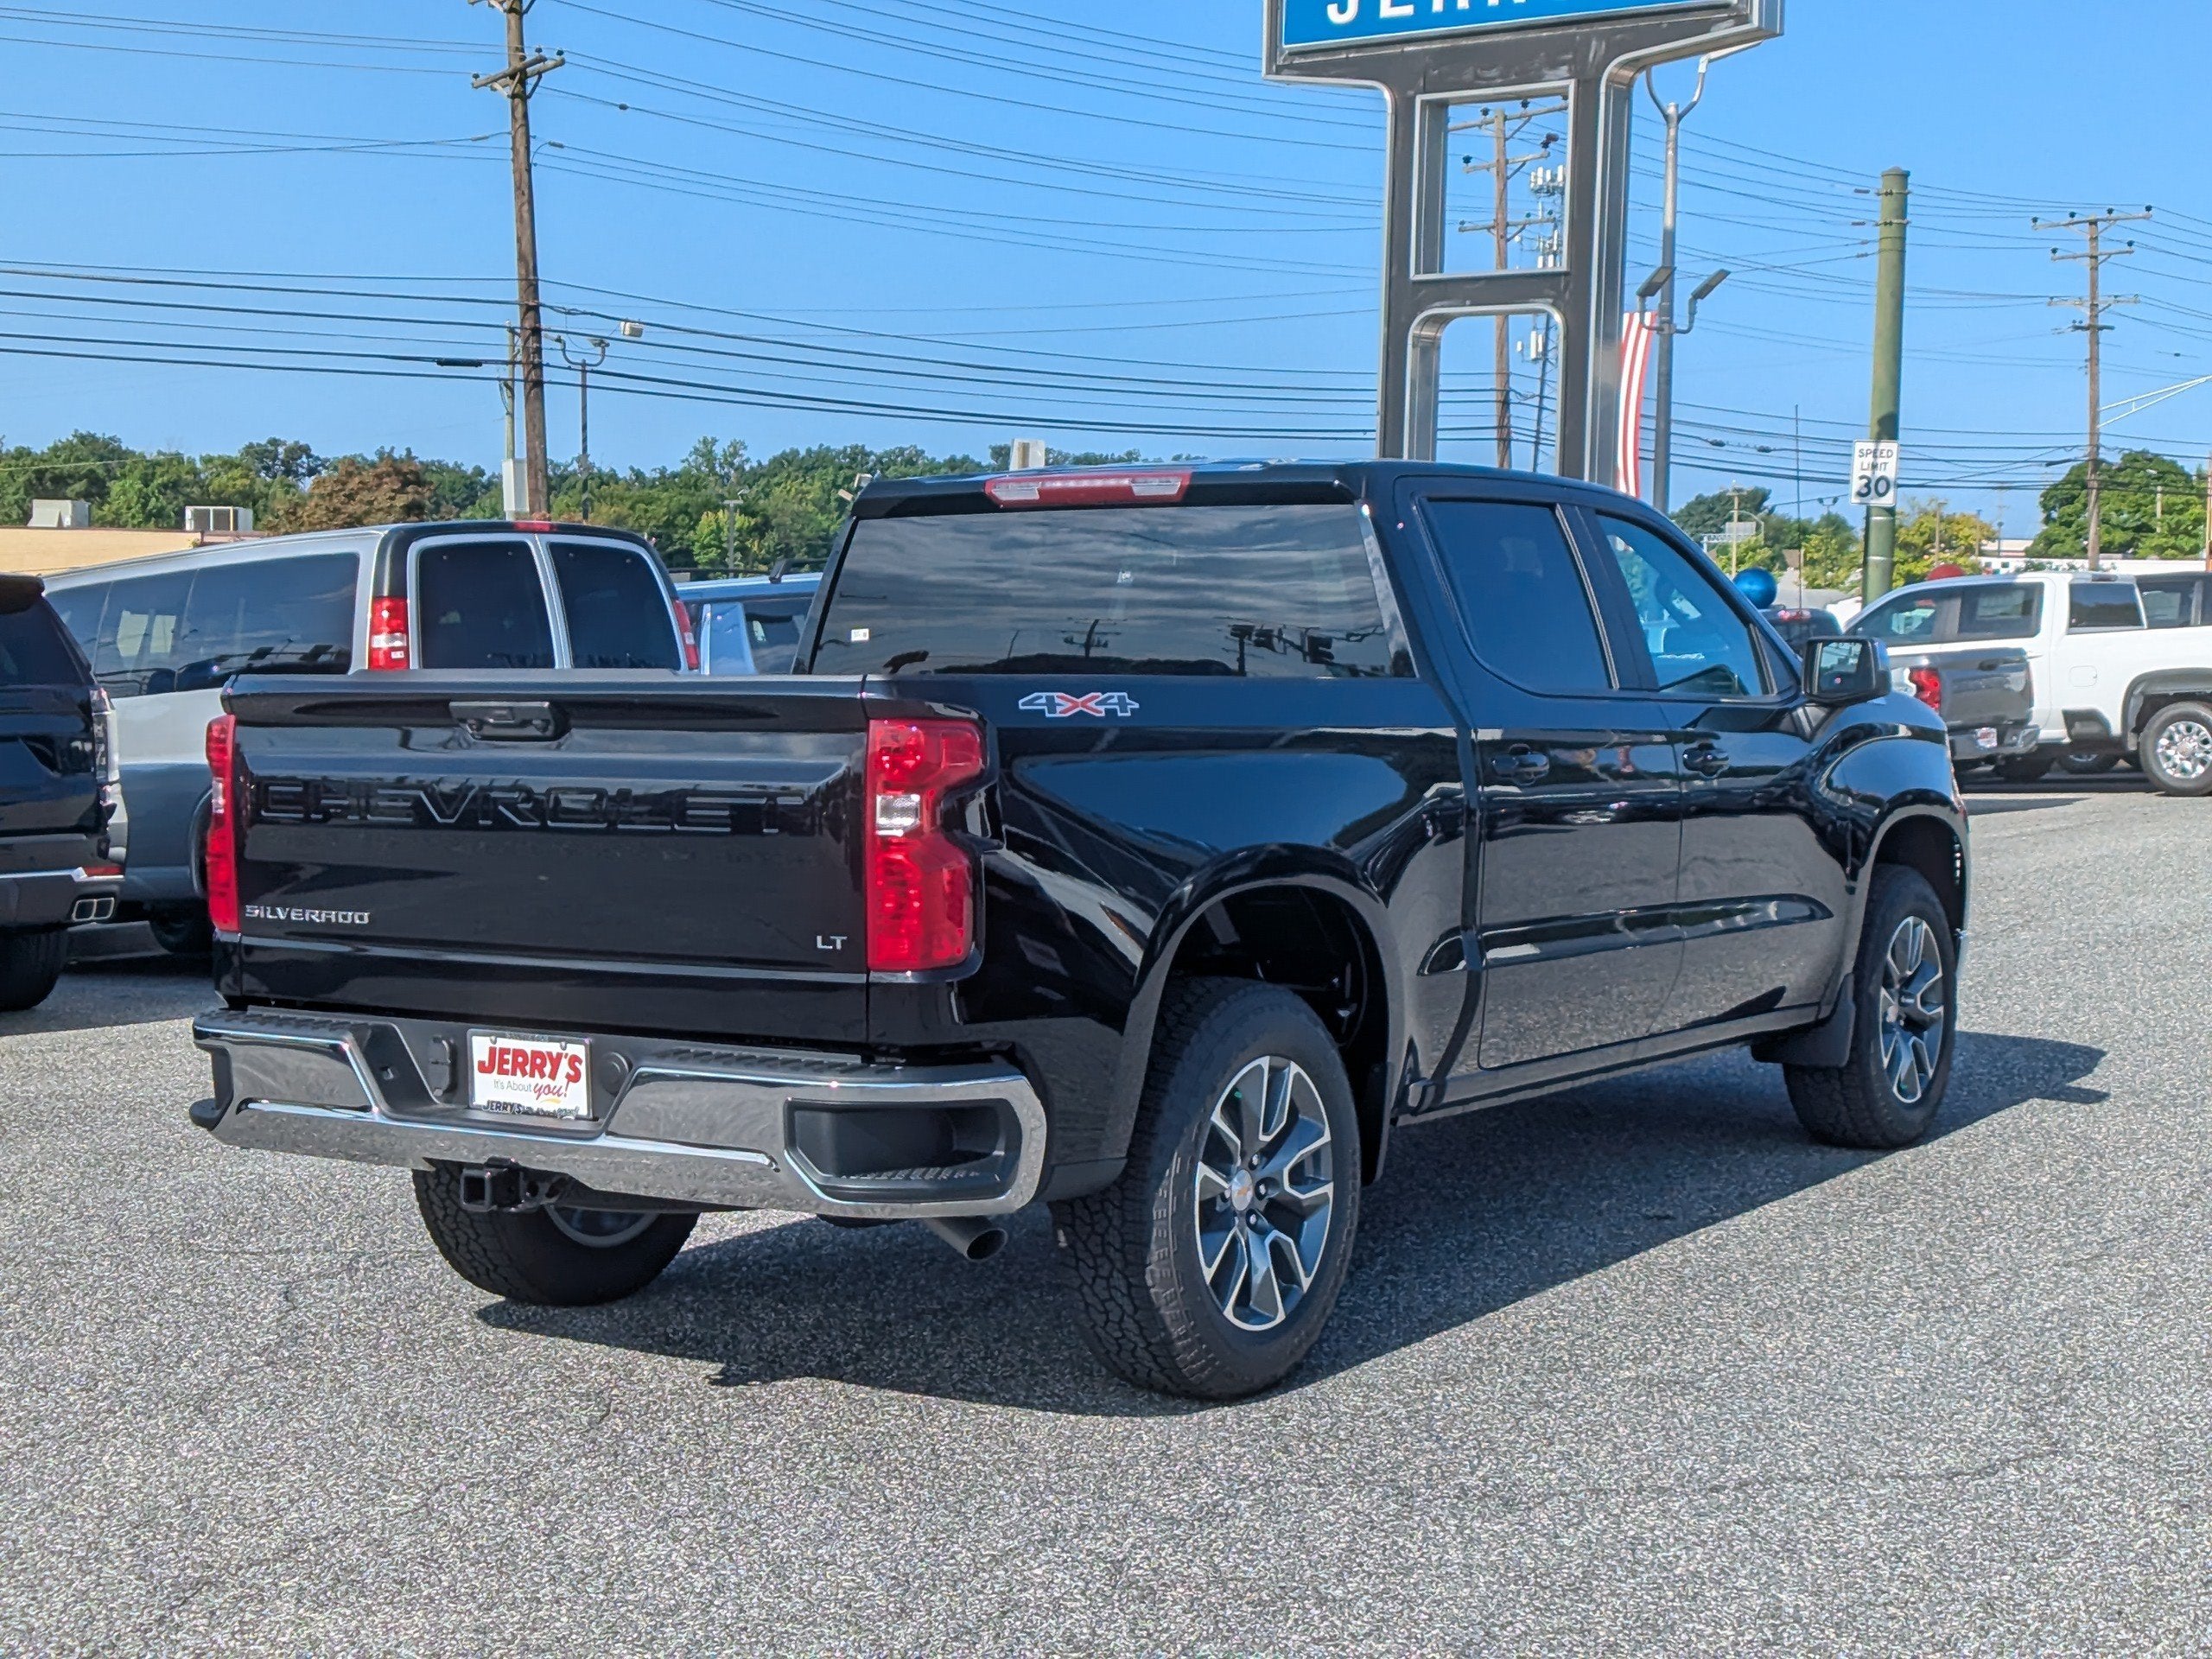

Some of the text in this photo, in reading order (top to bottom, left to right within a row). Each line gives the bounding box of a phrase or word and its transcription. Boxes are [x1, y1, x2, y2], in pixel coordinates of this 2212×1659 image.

[1859, 448, 1893, 458] SPEED
[1861, 461, 1889, 471] LIMIT
[1856, 474, 1891, 498] 30
[258, 781, 806, 834] CHEVROLET
[244, 903, 371, 925] SILVERADO
[815, 934, 848, 951] LT
[477, 1046, 583, 1084] JERRY'S
[493, 1078, 569, 1101] It's About you!
